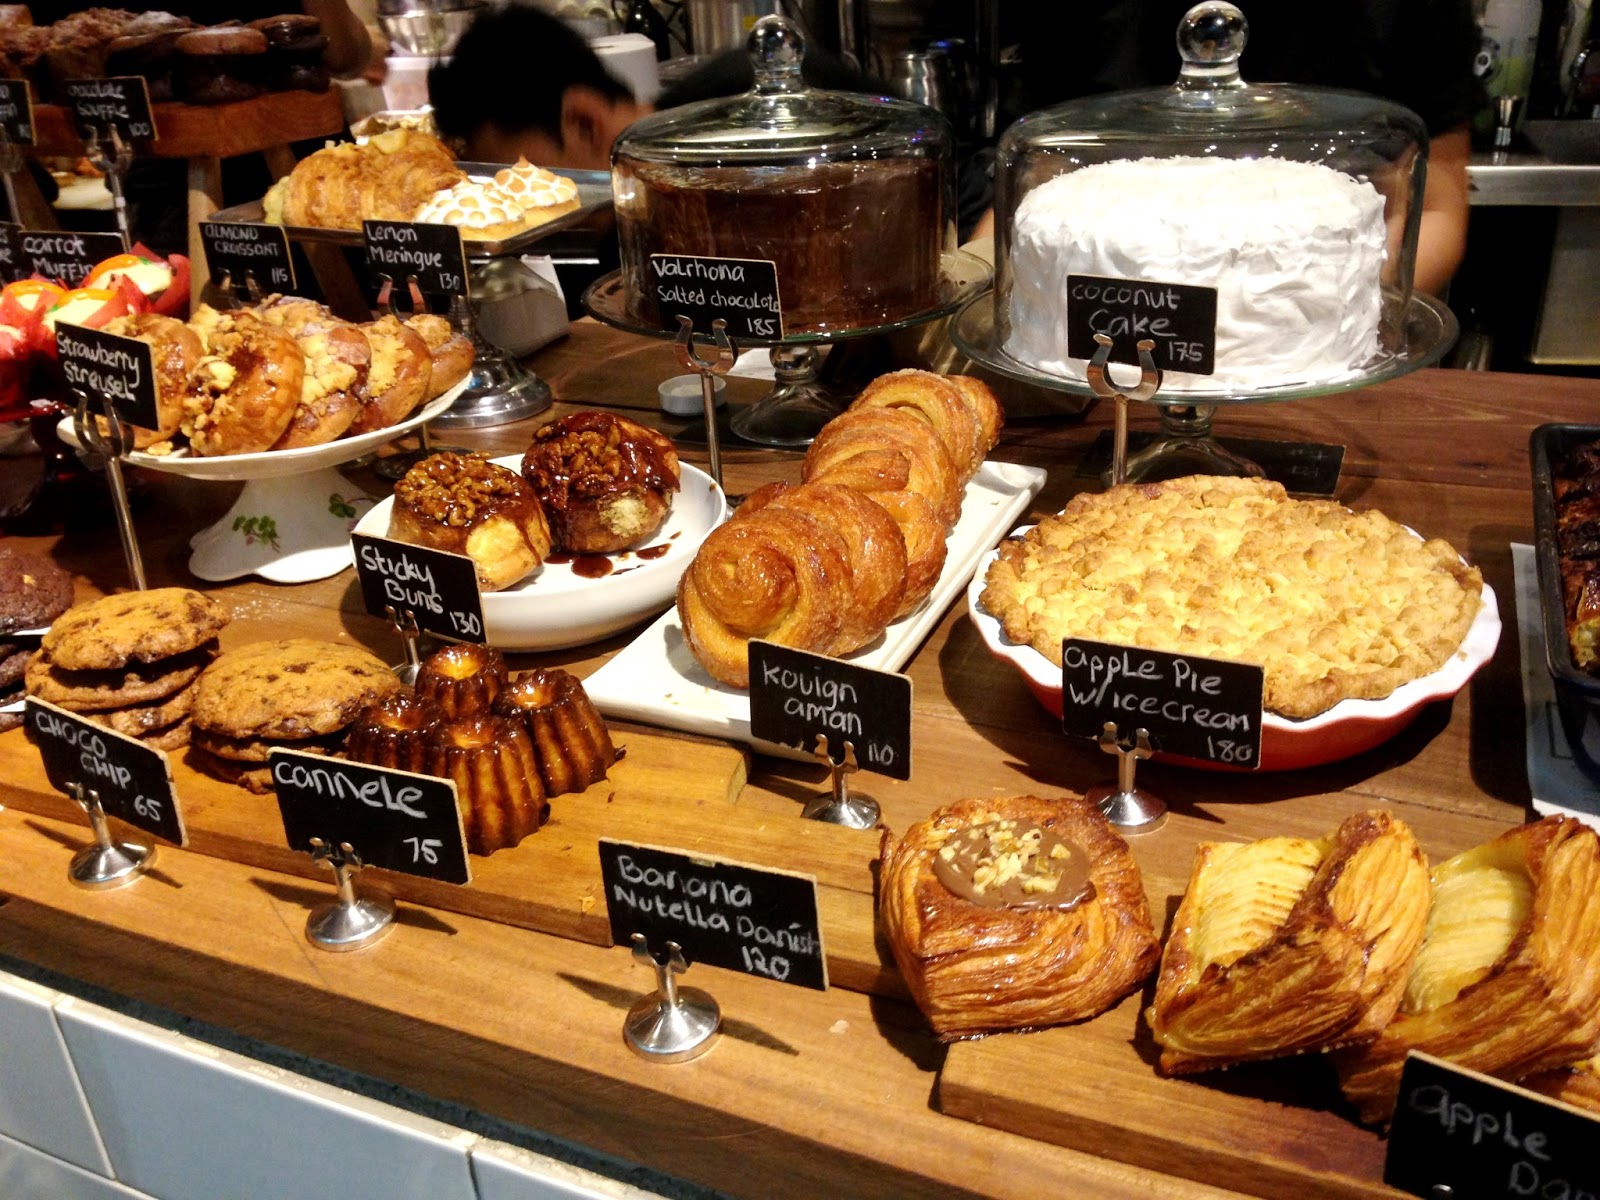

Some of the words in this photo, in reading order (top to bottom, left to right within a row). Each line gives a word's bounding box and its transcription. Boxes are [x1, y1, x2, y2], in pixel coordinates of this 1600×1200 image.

[365, 223, 418, 242] Lemon
[370, 245, 442, 271] Meringue
[271, 267, 288, 285] 115
[439, 272, 460, 290] 130
[657, 285, 706, 306] Salted
[710, 290, 780, 313] chocolate
[747, 317, 776, 336] 185
[56, 331, 140, 389] Strawberry
[1168, 341, 1204, 362] 175
[63, 360, 137, 402] Streusel
[361, 545, 437, 598] Sticky
[384, 578, 444, 614] Buns
[449, 611, 481, 636] 130
[1172, 658, 1222, 695] Pie
[35, 711, 107, 759] CHOCO
[1207, 735, 1252, 762] 180
[868, 743, 894, 766] 110
[80, 752, 132, 789] CHIP
[134, 795, 162, 822] 65
[403, 837, 443, 865] 75
[617, 855, 752, 908] Banana
[613, 884, 730, 933] Nutella
[741, 945, 790, 981] 120
